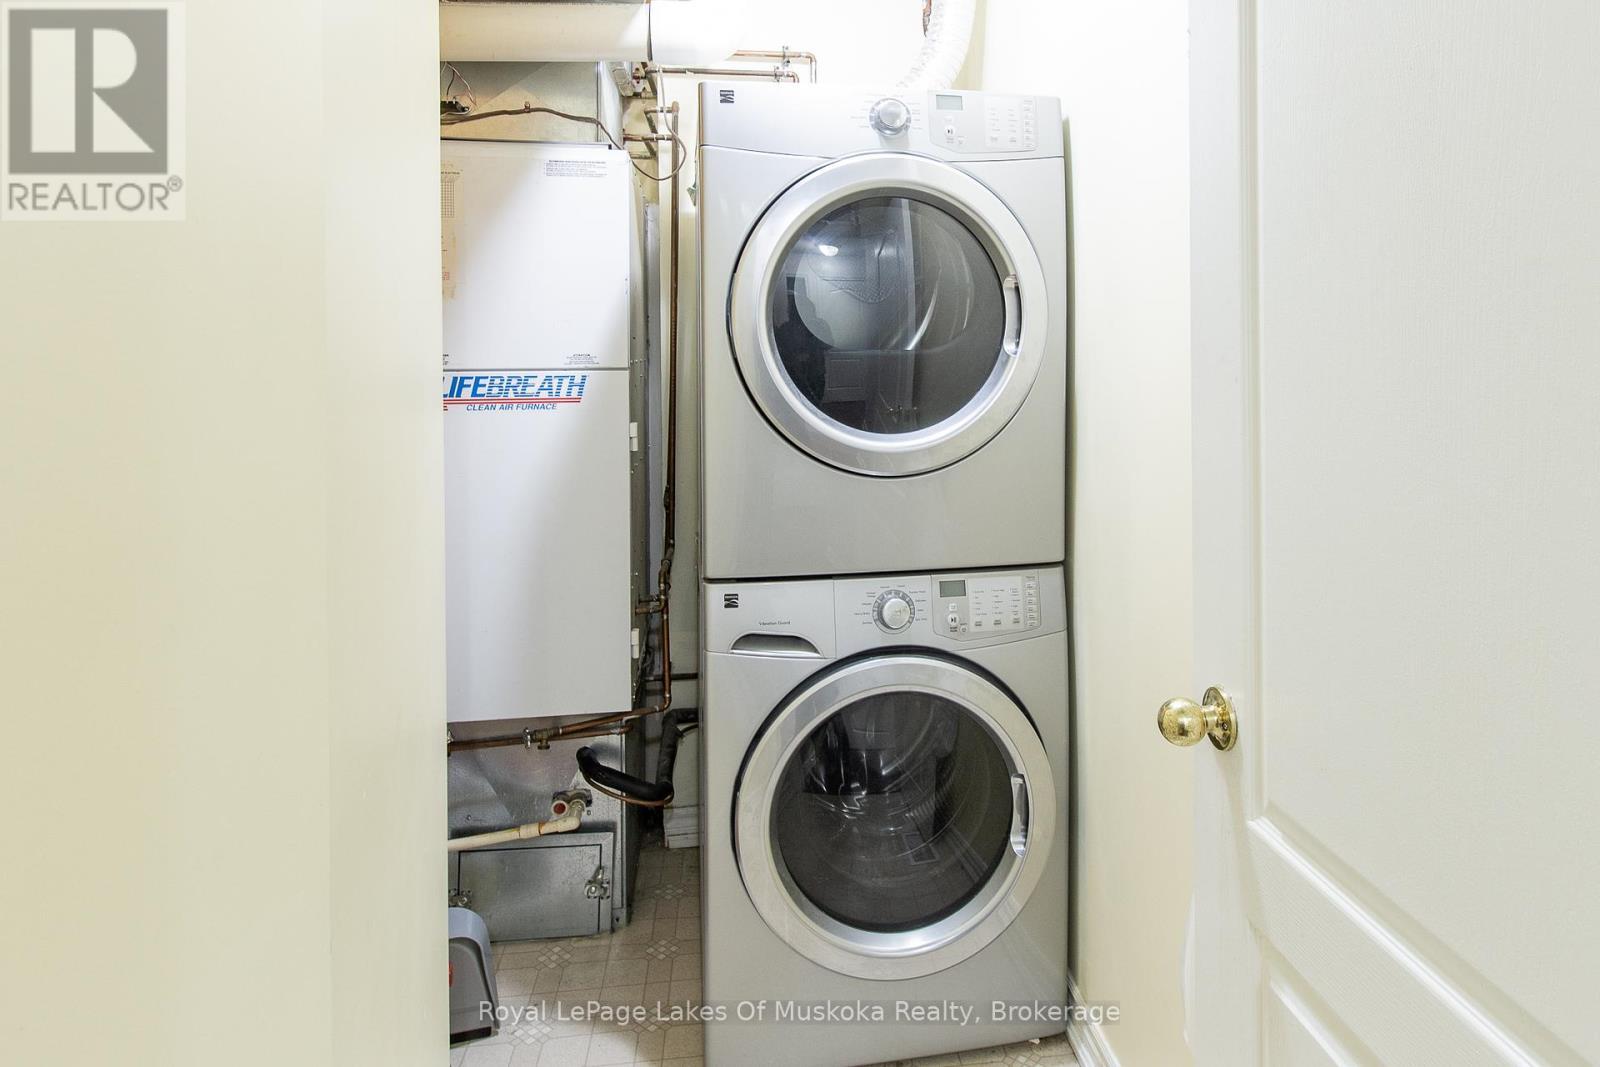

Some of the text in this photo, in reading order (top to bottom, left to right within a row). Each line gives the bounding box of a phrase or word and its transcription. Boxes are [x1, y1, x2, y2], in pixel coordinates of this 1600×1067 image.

[466, 403, 557, 412] CLEAN AIR FURNACE
